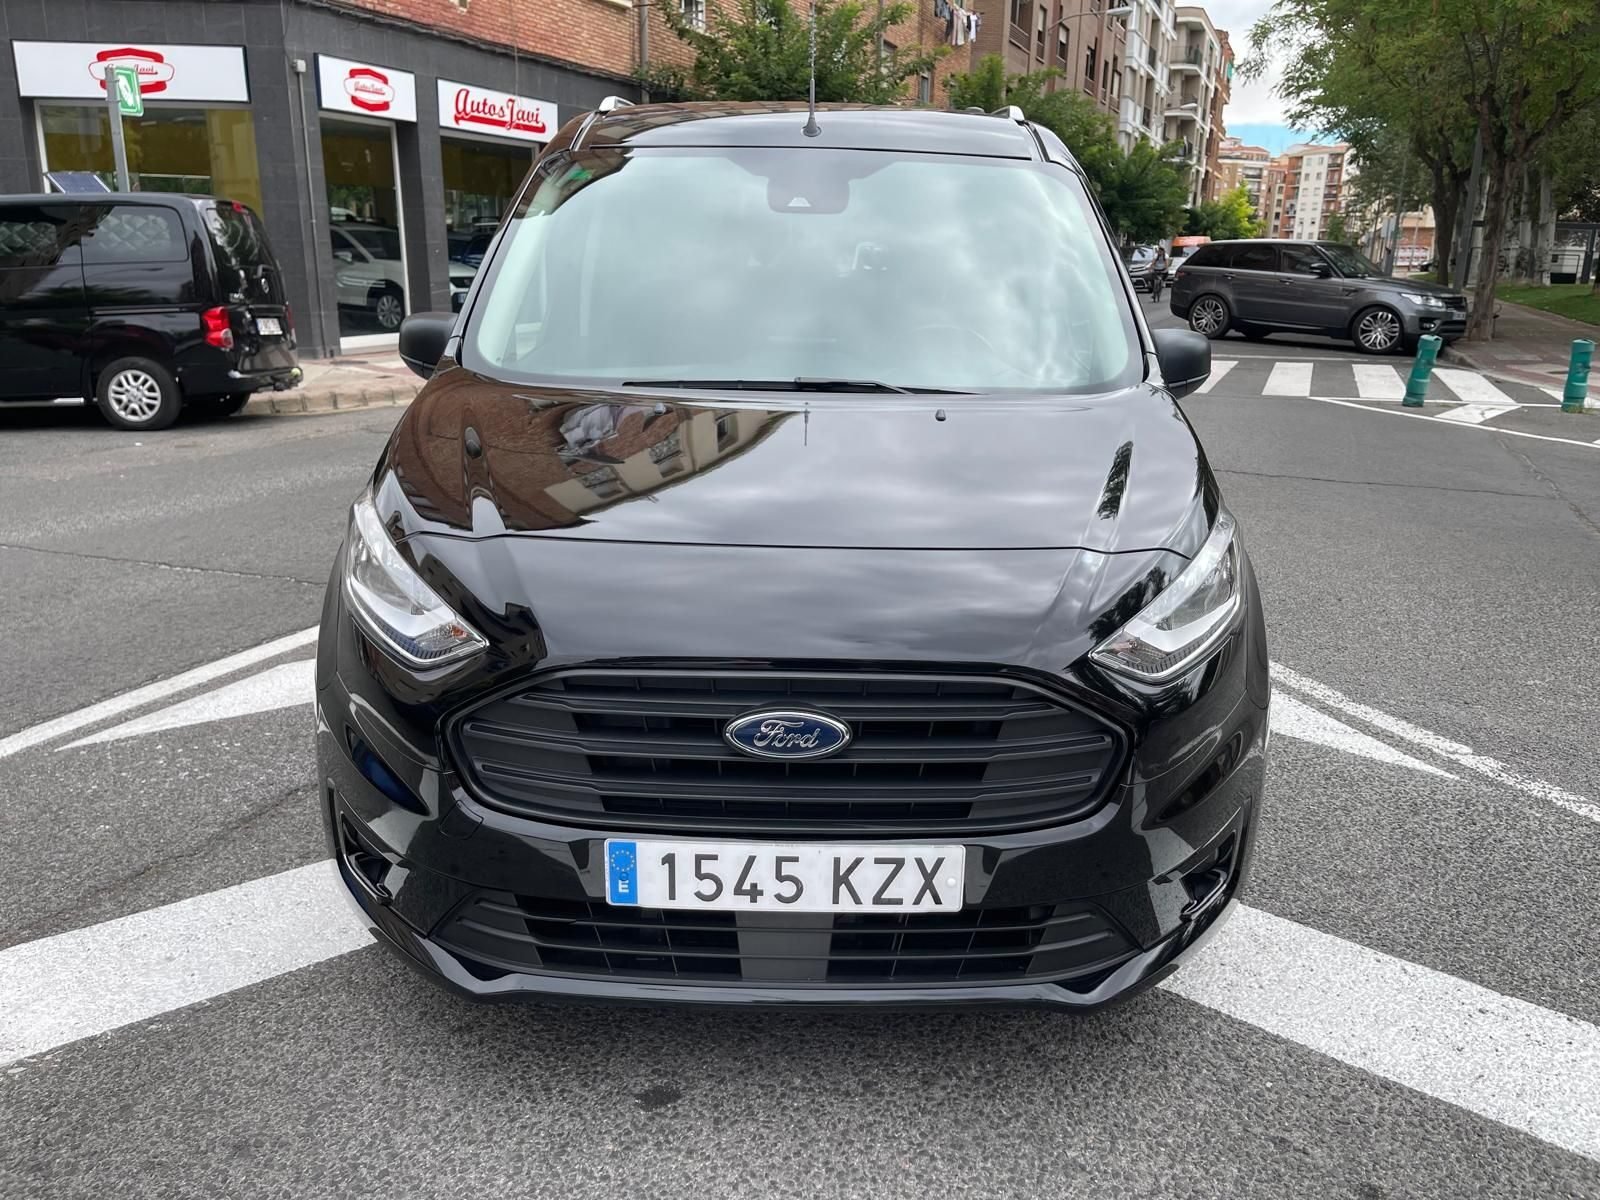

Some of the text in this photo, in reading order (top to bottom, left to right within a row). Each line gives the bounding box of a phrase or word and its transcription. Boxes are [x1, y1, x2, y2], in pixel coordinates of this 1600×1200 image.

[753, 719, 821, 748] Ford
[618, 879, 630, 893] E
[660, 852, 947, 906] 1545 KZX
